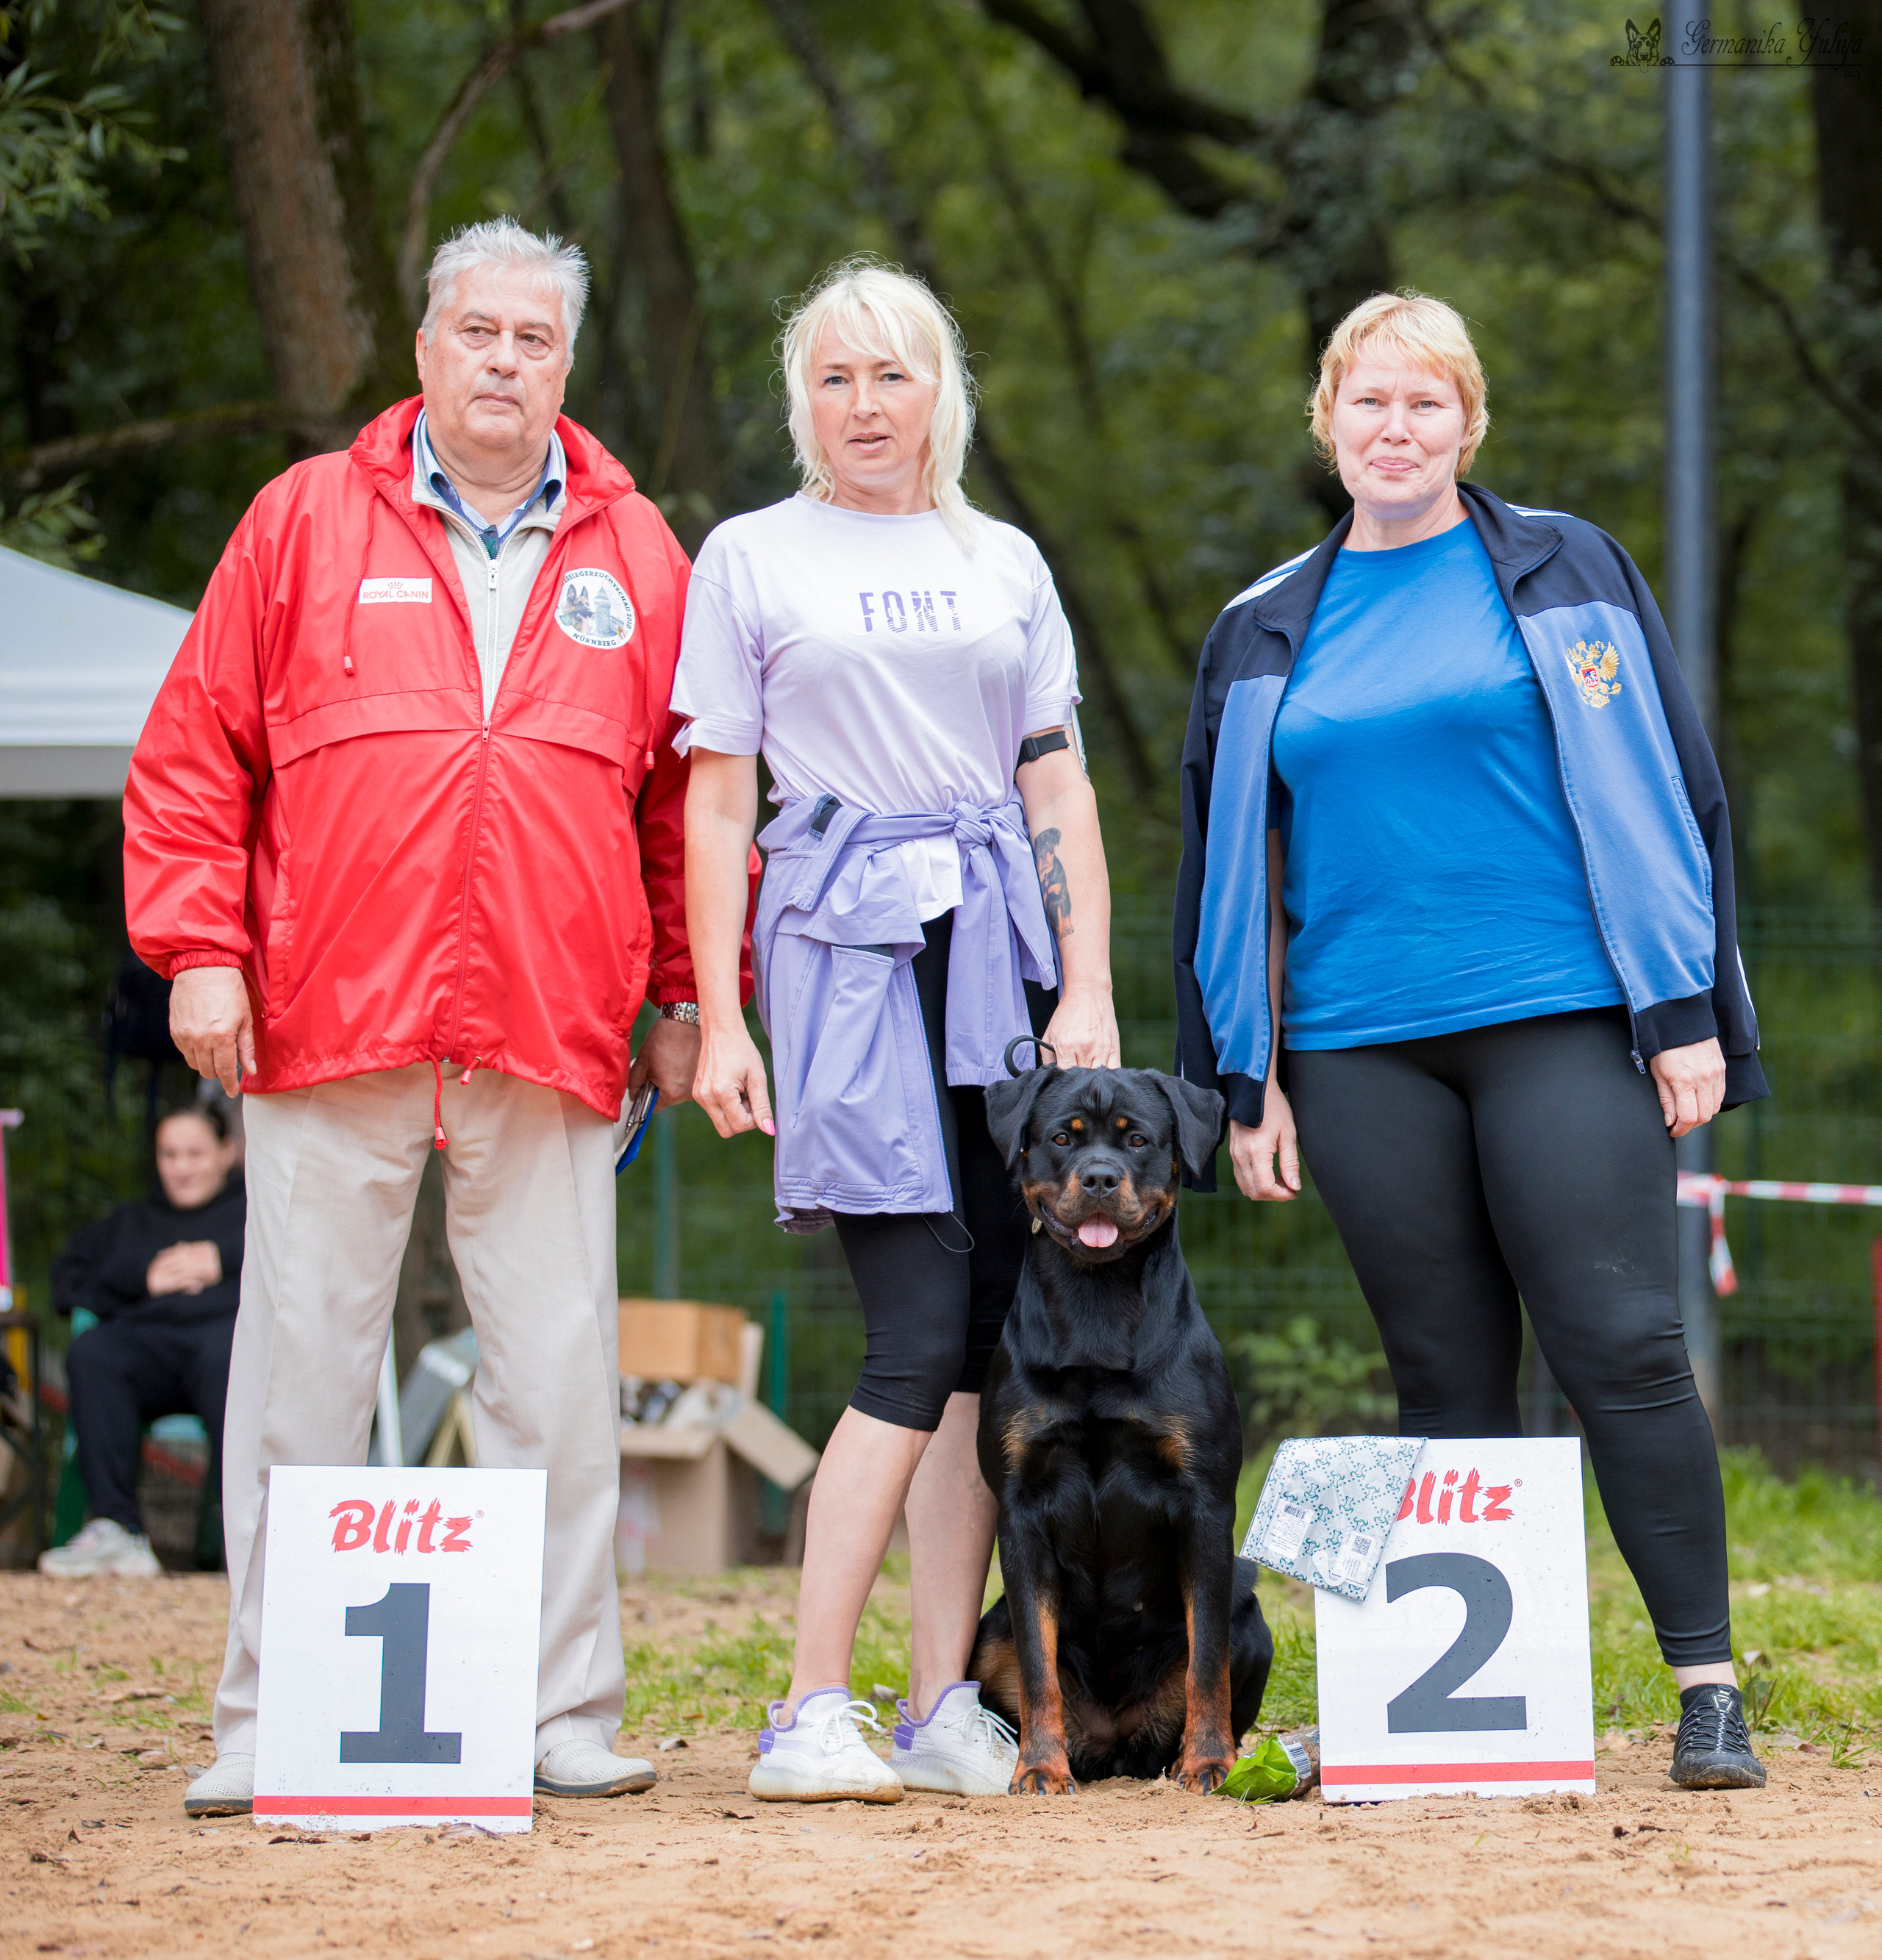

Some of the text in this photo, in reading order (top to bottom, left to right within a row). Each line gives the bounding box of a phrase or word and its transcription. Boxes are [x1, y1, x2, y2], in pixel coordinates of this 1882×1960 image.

[362, 590, 429, 599] ROYAL CANIN
[859, 590, 962, 633] FONT
[573, 632, 617, 647] NÜRNBERG
[329, 1497, 474, 1556] Blitz
[1385, 1552, 1528, 1734] 2
[340, 1582, 462, 1764] 1
